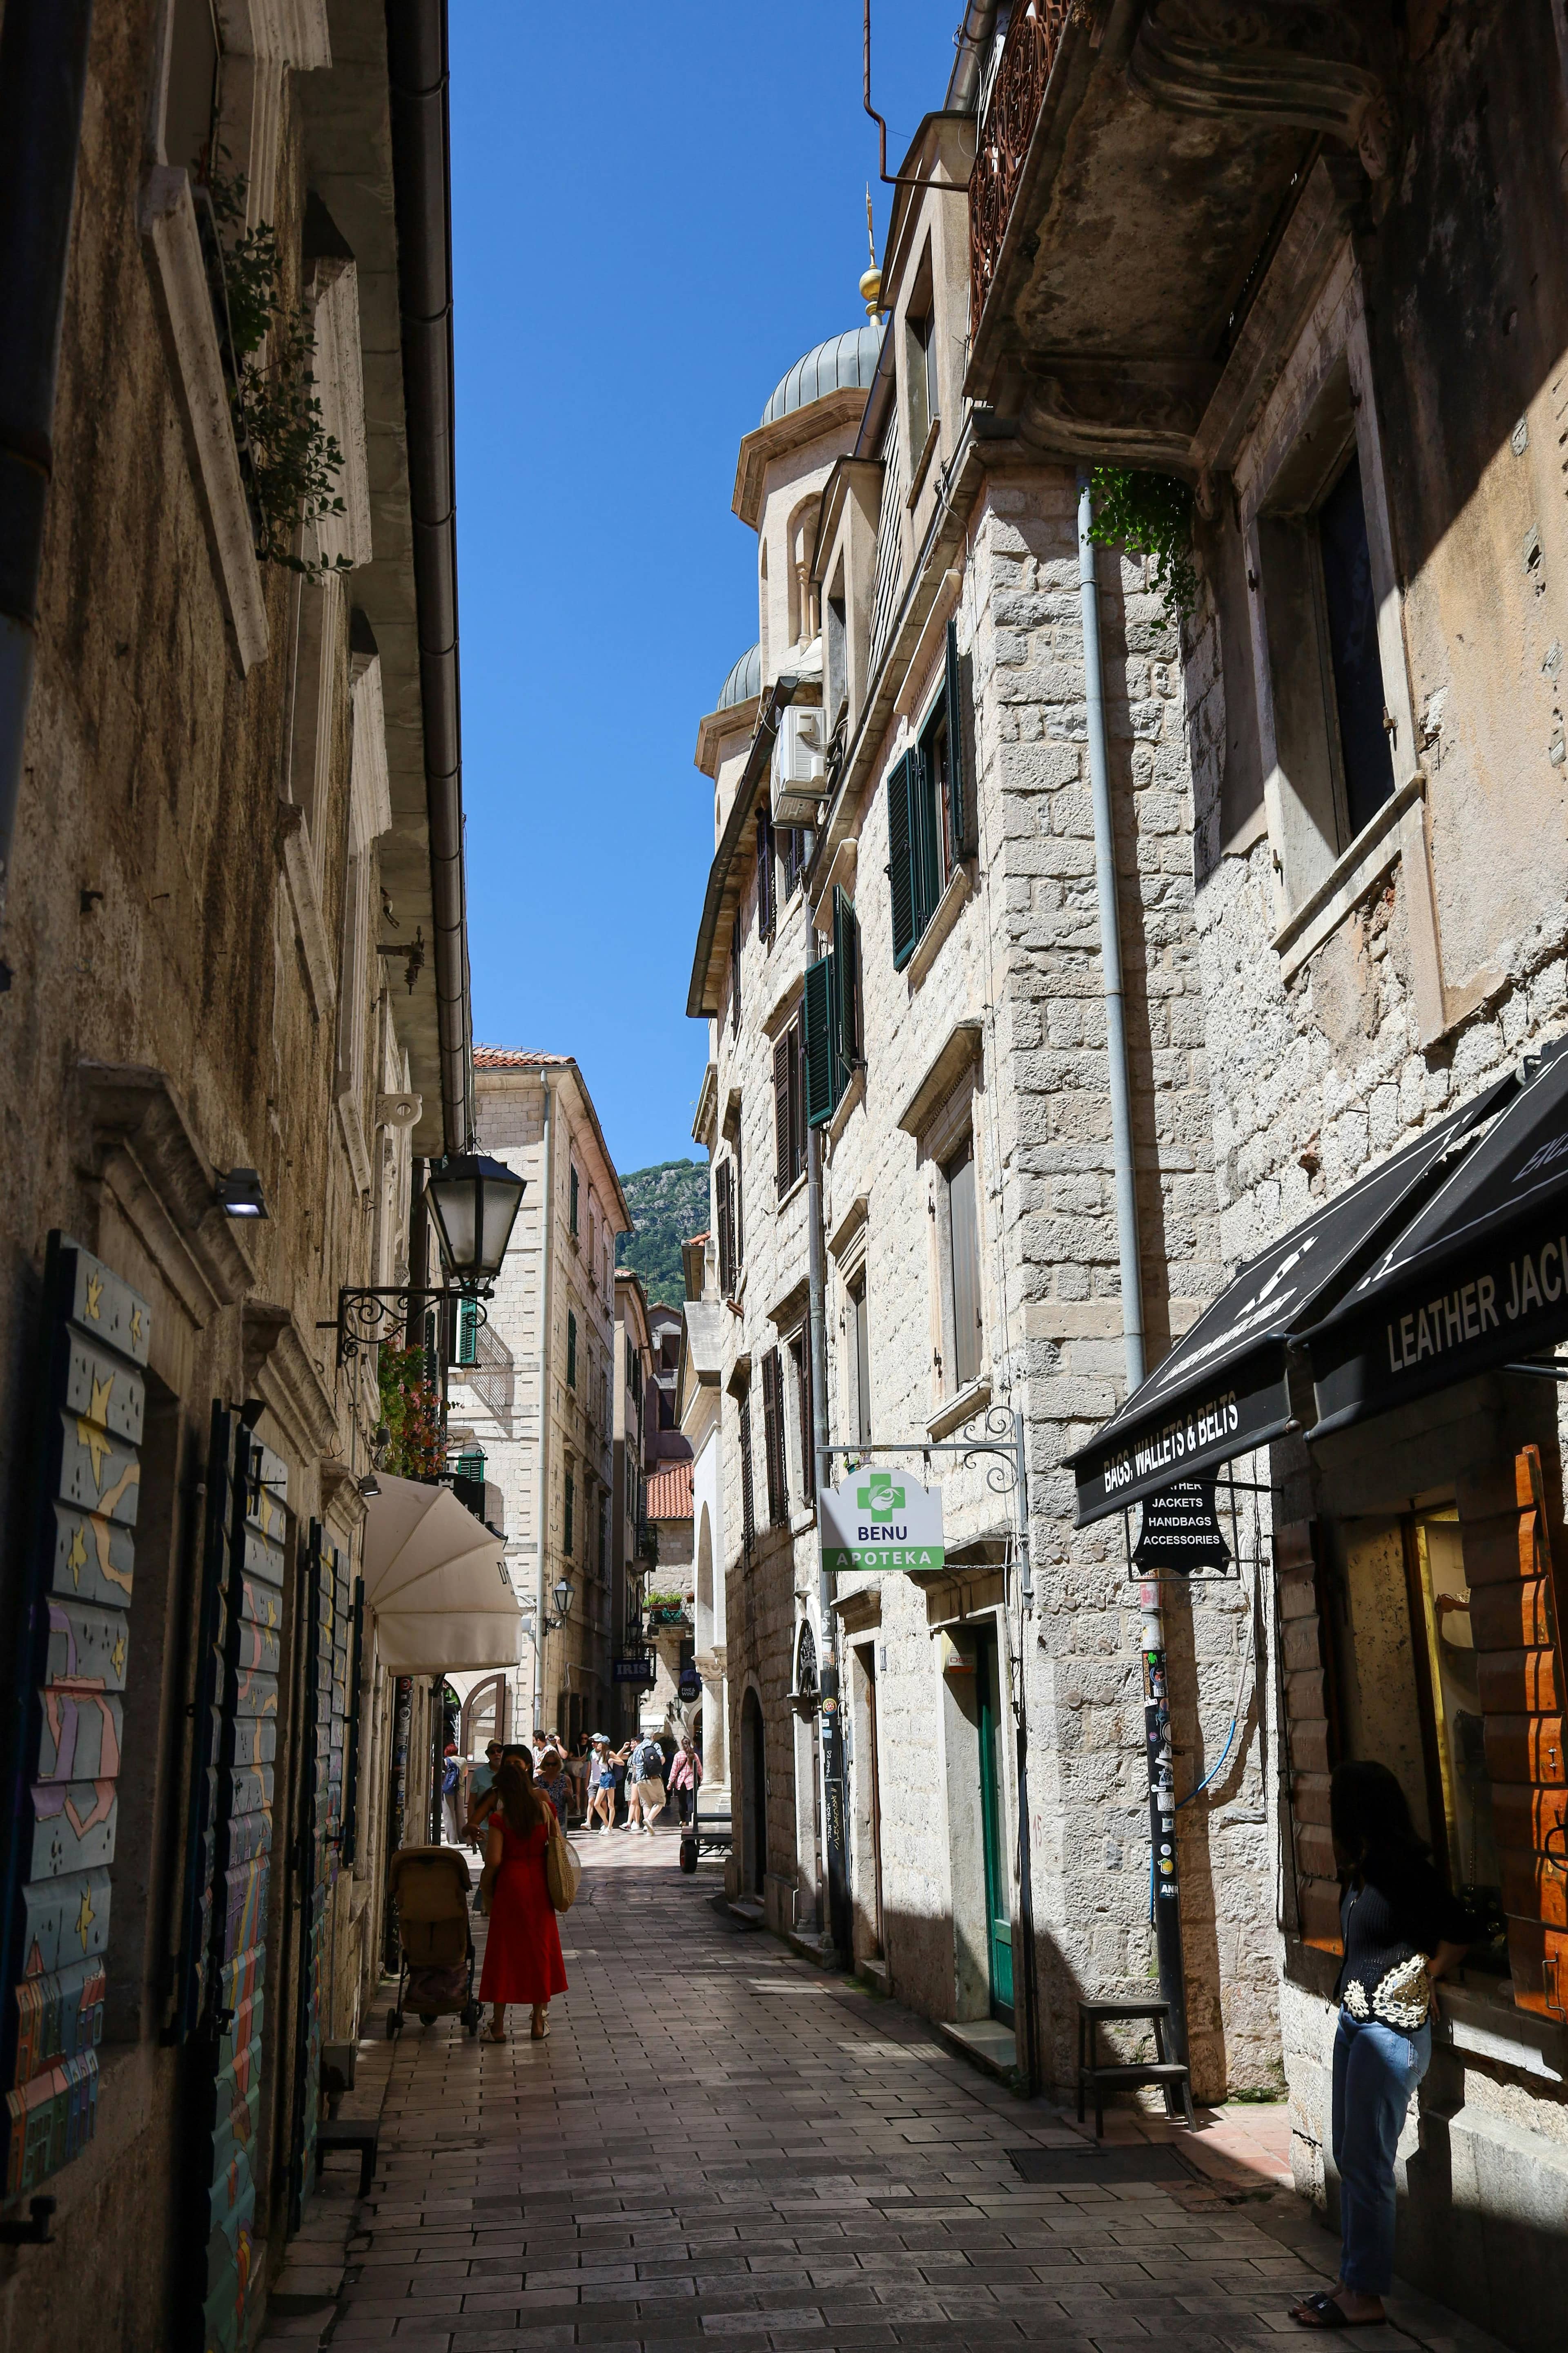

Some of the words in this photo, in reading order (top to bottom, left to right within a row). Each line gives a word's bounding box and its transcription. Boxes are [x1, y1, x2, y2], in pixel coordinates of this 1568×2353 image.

[1388, 1275, 1500, 1372] LEATHER
[1104, 1450, 1133, 1493] BAGS,
[1134, 1420, 1185, 1477] WALLETS
[1187, 1414, 1196, 1451] &
[1197, 1390, 1238, 1446] BELTS
[1152, 1498, 1203, 1508] JACKETS
[1149, 1517, 1212, 1527] HANDBAGS
[858, 1526, 907, 1541] BENU
[1143, 1536, 1220, 1545] ACCESSORIES
[836, 1551, 931, 1566] APOTEKA
[617, 1664, 647, 1675] IRIS
